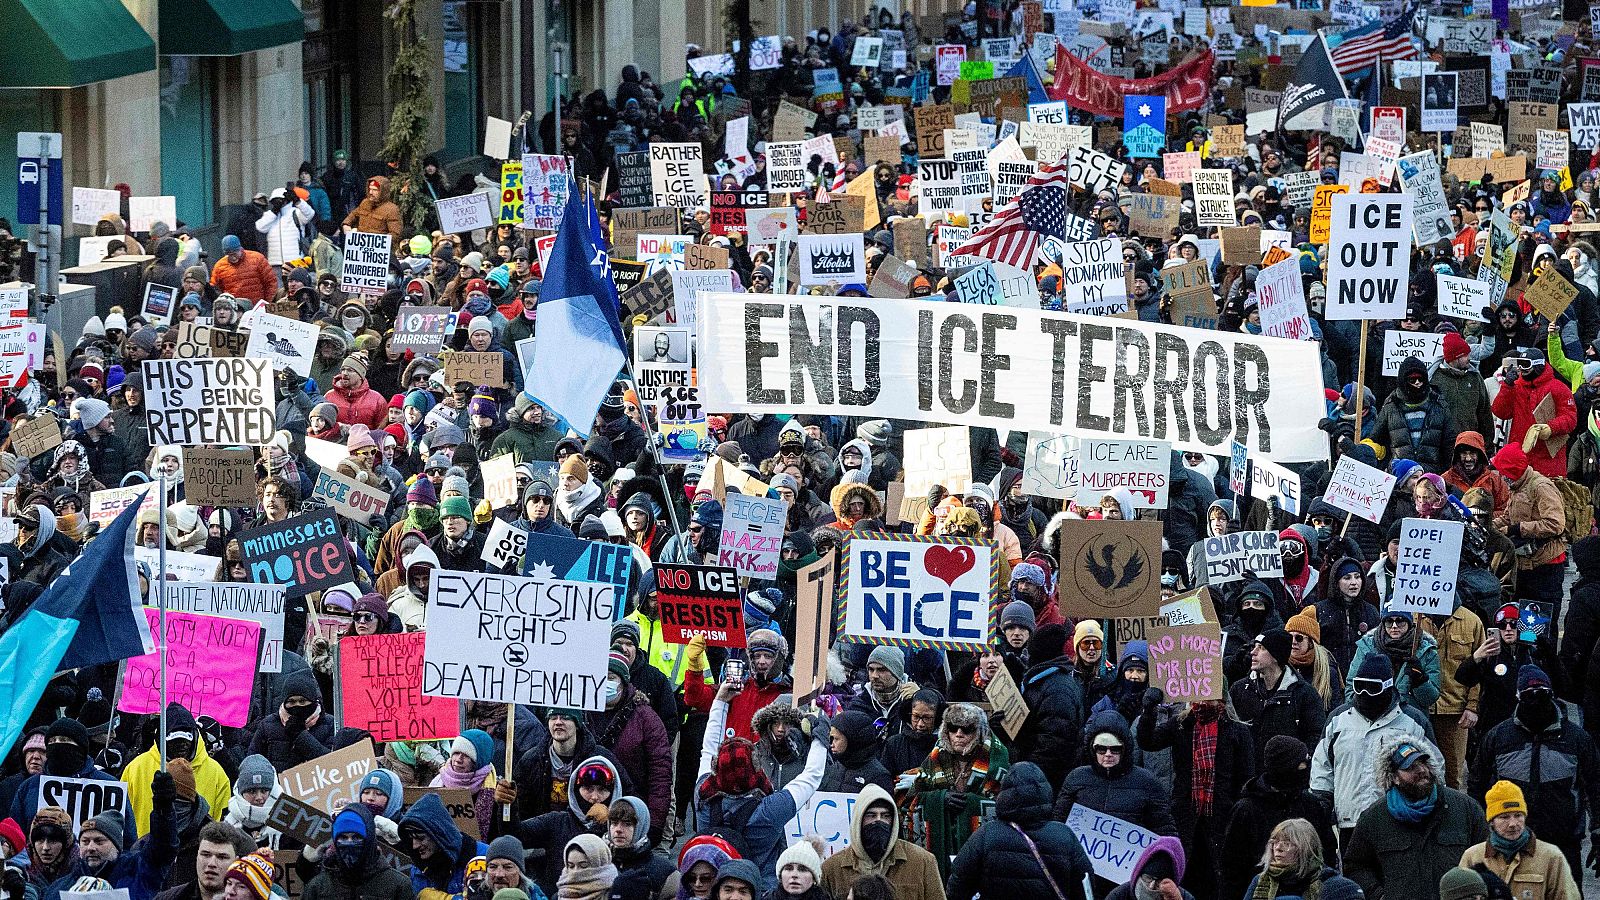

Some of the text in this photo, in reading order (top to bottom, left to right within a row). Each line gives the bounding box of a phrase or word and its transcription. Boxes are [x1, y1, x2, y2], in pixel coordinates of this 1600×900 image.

[1263, 95, 1279, 105] OUT
[860, 110, 878, 118] ICE
[1520, 104, 1547, 116] ICE
[863, 120, 880, 128] OUT
[919, 115, 952, 127] INCEL
[1036, 113, 1063, 124] EYES
[1034, 125, 1068, 134] THE TIME
[1136, 126, 1153, 136] THIS
[1473, 125, 1485, 135] NO
[1032, 133, 1081, 142] ALWAYS RIGHT
[1125, 135, 1146, 143] STATE
[1045, 142, 1058, 150] DO
[1136, 143, 1154, 152] RUN
[621, 155, 637, 165] NOT
[652, 146, 702, 161] RATHER
[770, 149, 802, 158] JONATHAN
[953, 150, 986, 162] GENERAL
[665, 163, 689, 176] BE
[772, 158, 801, 167] ROSS FOR
[999, 163, 1035, 174] GENERAL
[1075, 147, 1123, 178] ICE
[771, 169, 805, 182] MURDER
[922, 162, 958, 181] STOP
[966, 173, 989, 184] PATH TO
[1069, 163, 1118, 189] OUT
[1195, 172, 1229, 182] EXPAND THE
[665, 180, 696, 192] ICE
[923, 187, 960, 196] ICE TERROR
[997, 186, 1008, 195] THE
[1196, 182, 1231, 195] GENERAL
[439, 199, 459, 210] MAKE
[655, 194, 706, 207] FISHING
[713, 193, 767, 205] NO ICE
[815, 200, 841, 211] GET
[931, 197, 954, 209] NOW!
[1200, 199, 1230, 213] STRIKE!
[452, 206, 477, 217] AFRAID
[616, 209, 673, 228] Will Trade
[809, 210, 845, 222] YOUR
[1349, 203, 1402, 229] ICE
[453, 216, 478, 226] AGAIN
[347, 232, 387, 248] JUSTICE
[640, 239, 658, 253] NO
[345, 250, 388, 264] ALL THOSE
[690, 246, 715, 269] Stop
[1070, 239, 1112, 264] STOP
[1340, 241, 1399, 268] OUT
[814, 256, 851, 269] Abolish
[343, 264, 386, 277] MURDERED
[620, 272, 640, 281] RIGHT
[1064, 262, 1124, 285] KIDNAPPING
[343, 276, 385, 287] BY ICE
[696, 275, 728, 287] DECENT
[957, 265, 995, 303] FUCK
[1444, 280, 1458, 290] THE
[1083, 284, 1105, 304] MY
[1338, 278, 1398, 304] NOW
[1452, 292, 1472, 307] ICE
[1452, 306, 1480, 318] MELTING
[288, 322, 310, 339] Belong
[393, 334, 429, 344] HARRIS
[1395, 334, 1426, 348] Jesus
[3, 342, 26, 352] LIVING
[1390, 350, 1409, 358] was
[448, 354, 500, 365] ABOLISH
[143, 359, 267, 390] HISTORY
[453, 369, 494, 380] ICE
[638, 369, 688, 387] JUSTICE
[745, 302, 1272, 453] END ICE TERROR
[162, 390, 262, 406] IS BEING
[667, 404, 701, 420] OUT
[146, 408, 276, 446] REPEATED
[1090, 443, 1158, 462] ICE ARE
[205, 458, 230, 468] cripes
[1338, 459, 1356, 472] THIS
[189, 467, 242, 485] ABOLISH
[1082, 472, 1166, 488] MURDERERS
[1252, 466, 1275, 487] END
[1278, 476, 1298, 500] ICE
[1334, 468, 1366, 488] FEELS
[207, 485, 229, 498] ICE
[315, 472, 386, 516] ICE OUT
[1328, 481, 1372, 506] FAMILIAR
[732, 500, 782, 524] ICE
[243, 514, 338, 558] minnesota
[722, 530, 780, 552] NAZI
[1408, 528, 1443, 542] OPE!
[1206, 531, 1277, 556] OUR COLOR
[1403, 547, 1431, 559] ICE
[251, 541, 345, 588] noice
[587, 543, 630, 584] ICE
[860, 550, 910, 588] BE
[1248, 552, 1282, 572] CRIME
[1401, 562, 1442, 577] TIME
[658, 569, 737, 592] NO ICE
[1398, 578, 1452, 592] TO GO
[154, 586, 286, 614] WHITE NATIONALISM
[436, 575, 612, 621] EXERCISING
[1404, 594, 1440, 608] NOW
[661, 602, 740, 630] RESIST
[863, 590, 981, 639] NICE
[1172, 614, 1189, 623] OFF
[478, 613, 567, 645] RIGHTS
[680, 628, 727, 641] FASCISM
[207, 623, 259, 653] NOEM
[351, 636, 378, 646] YOU
[353, 644, 418, 658] TALK ABOUT
[1149, 633, 1222, 660] NO MORE
[187, 650, 195, 668] A
[361, 657, 424, 678] ILLEGA
[1156, 659, 1213, 679] MR ICE
[174, 672, 226, 695] FACED
[371, 677, 399, 689] WHEN
[423, 661, 606, 710] DEATH PENALTY
[1165, 677, 1212, 697] GUYS
[366, 687, 432, 709] VOTED
[376, 705, 417, 720] FOR A
[368, 717, 436, 740] FELON
[299, 757, 371, 797] Like my
[1091, 816, 1157, 848] ICE OUT
[1080, 834, 1136, 870] NOW!
